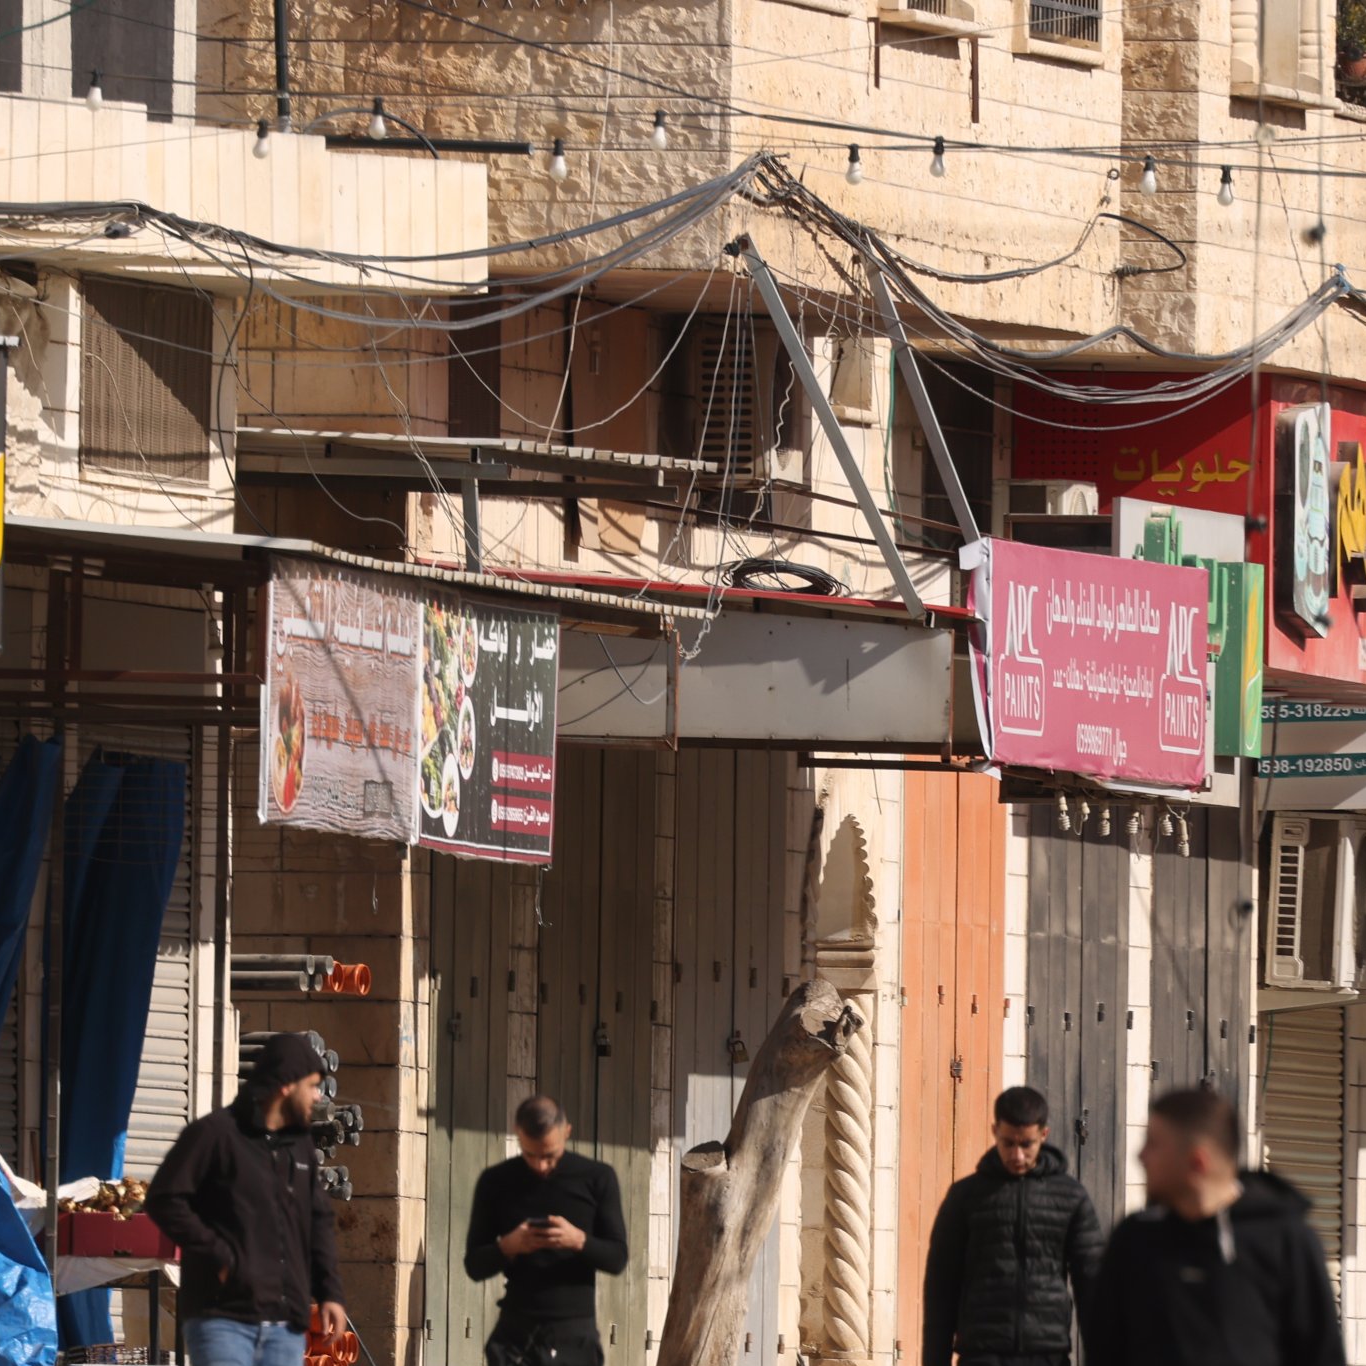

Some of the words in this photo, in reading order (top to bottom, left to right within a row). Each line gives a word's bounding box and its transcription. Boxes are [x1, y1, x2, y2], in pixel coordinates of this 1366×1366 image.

[1113, 447, 1252, 496] حلويات
[1005, 581, 1040, 656] APC
[1165, 602, 1200, 676] APC
[1004, 672, 1041, 721] PAINTS
[1164, 692, 1200, 740] PAINTS
